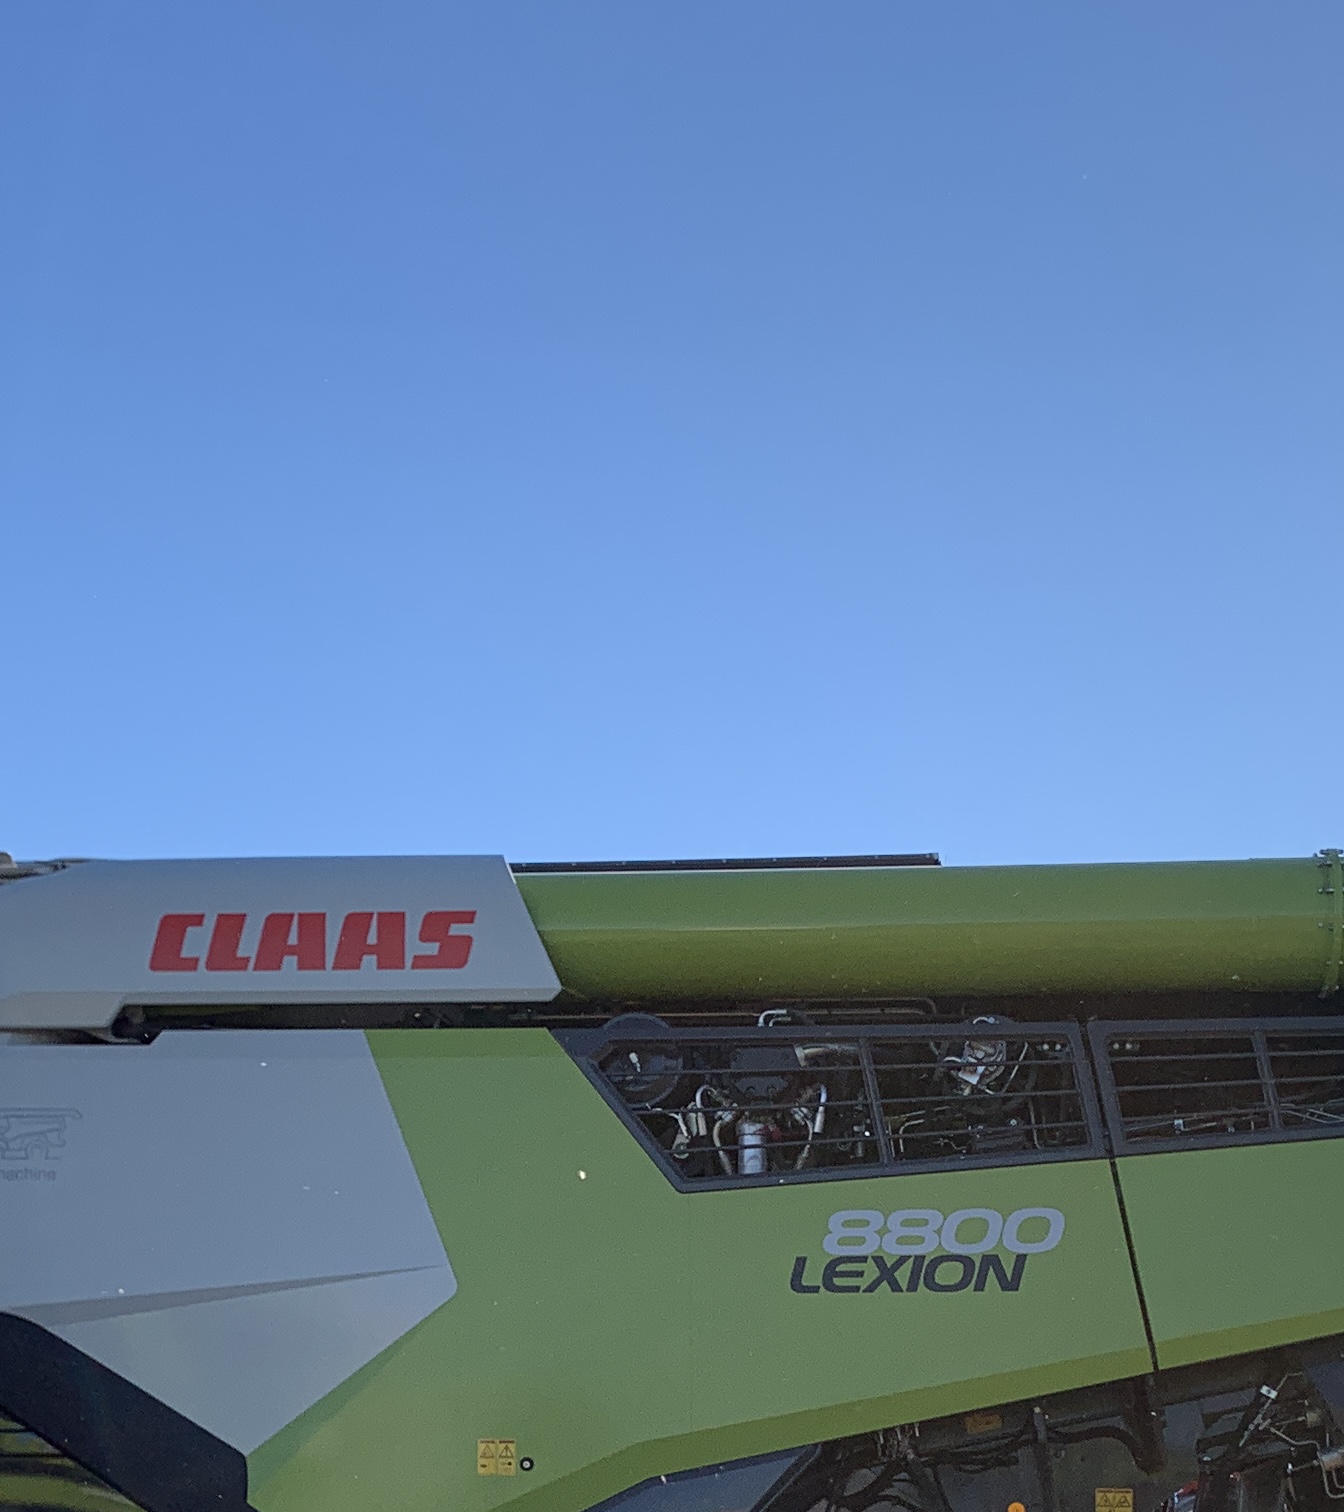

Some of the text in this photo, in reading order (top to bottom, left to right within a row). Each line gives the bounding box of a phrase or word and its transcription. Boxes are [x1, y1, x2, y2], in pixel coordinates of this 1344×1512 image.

[149, 910, 477, 972] CLAAS
[822, 1207, 1065, 1256] 8800
[790, 1253, 1027, 1293] LEXION
